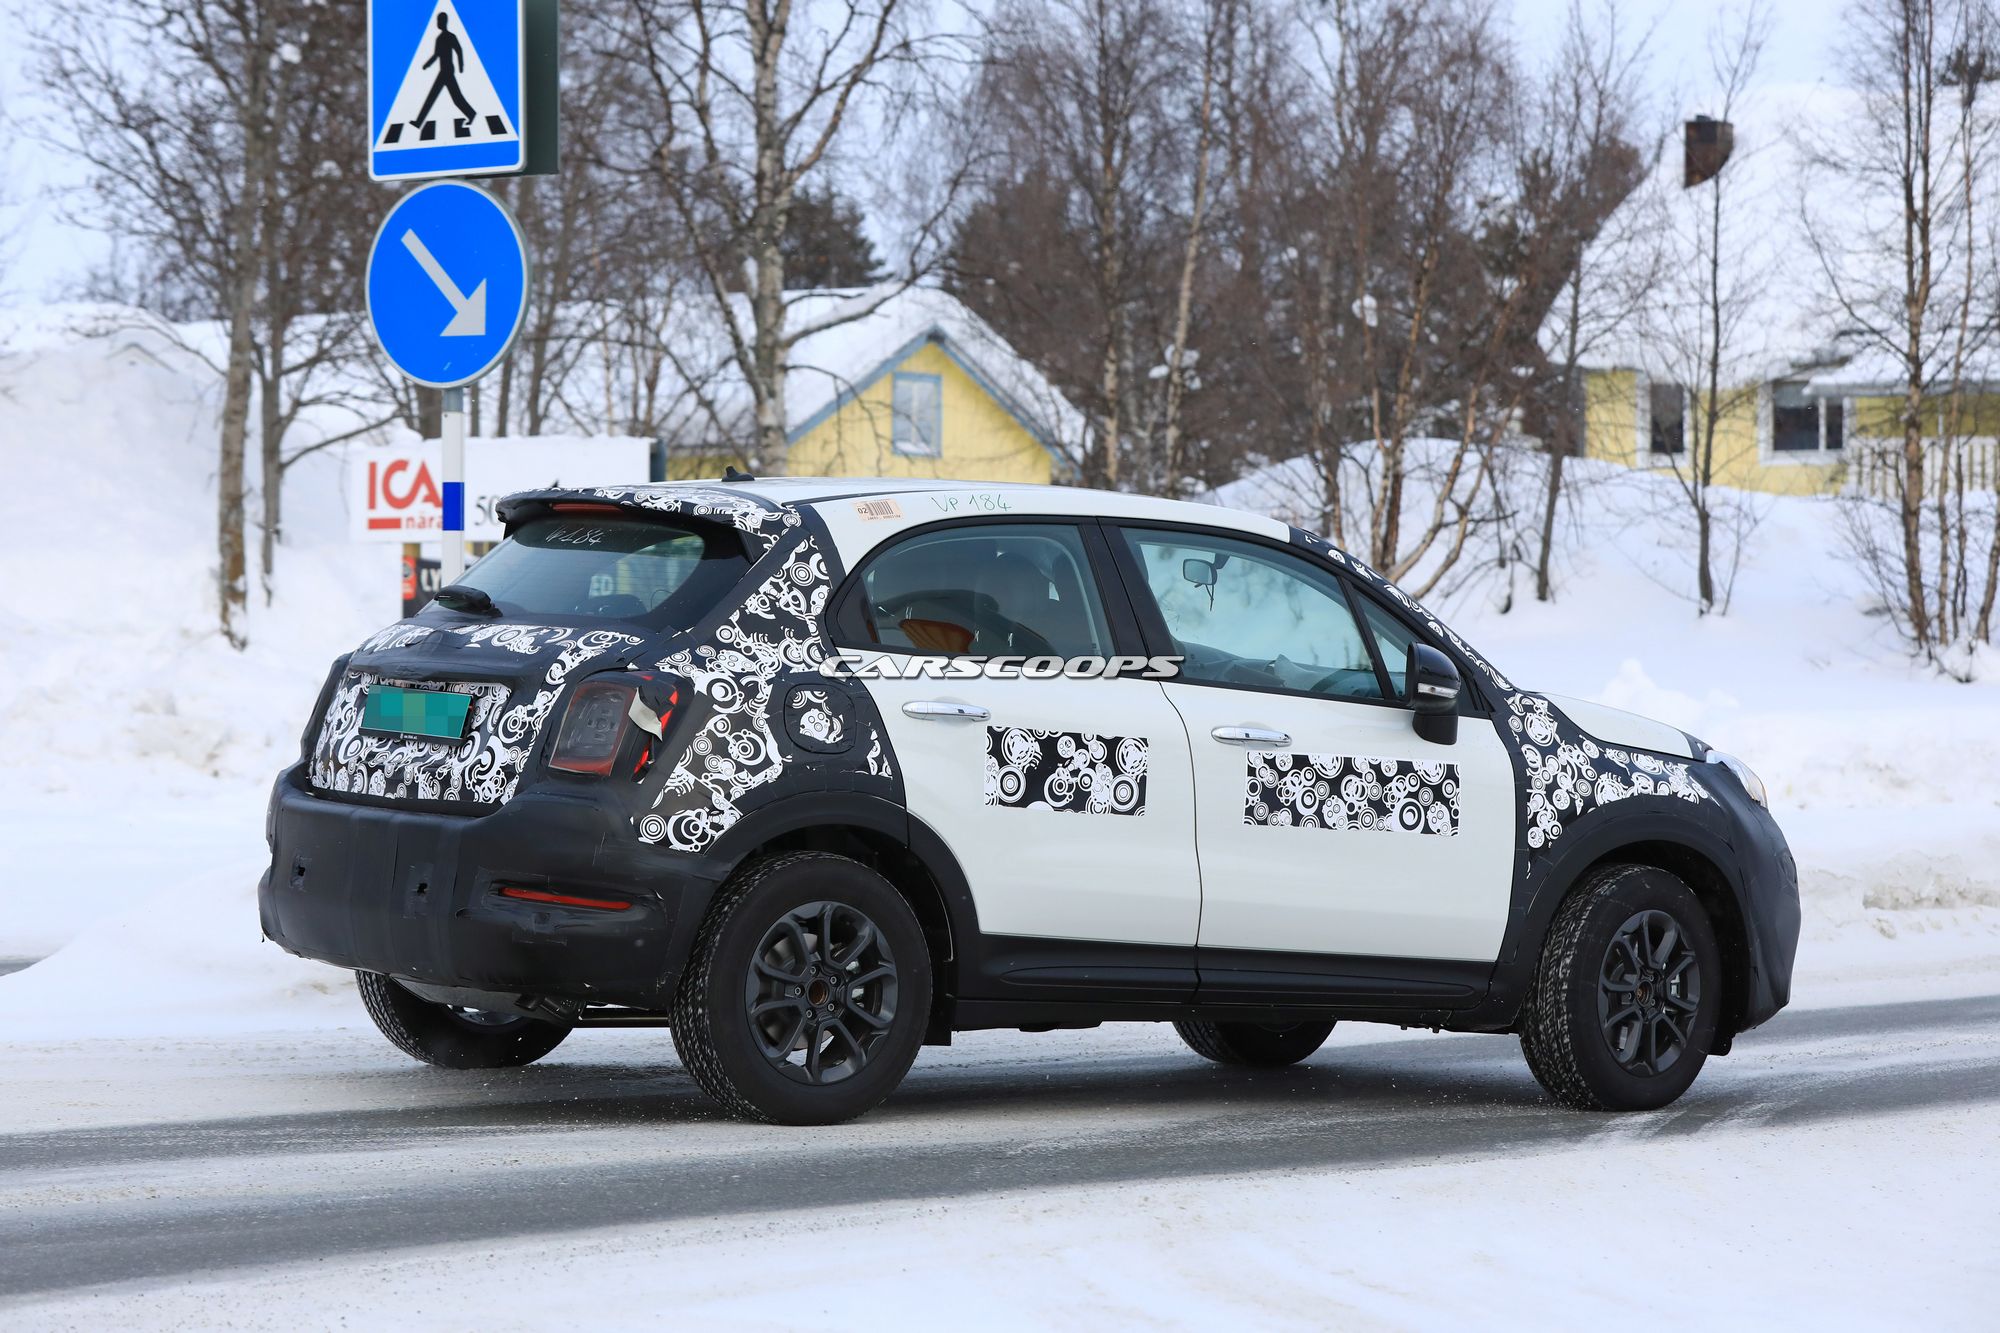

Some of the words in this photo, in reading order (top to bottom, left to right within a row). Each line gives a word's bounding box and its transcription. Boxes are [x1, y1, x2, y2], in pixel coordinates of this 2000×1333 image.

[368, 458, 443, 510] ICA
[931, 494, 958, 513] VP
[968, 493, 1012, 512] 184
